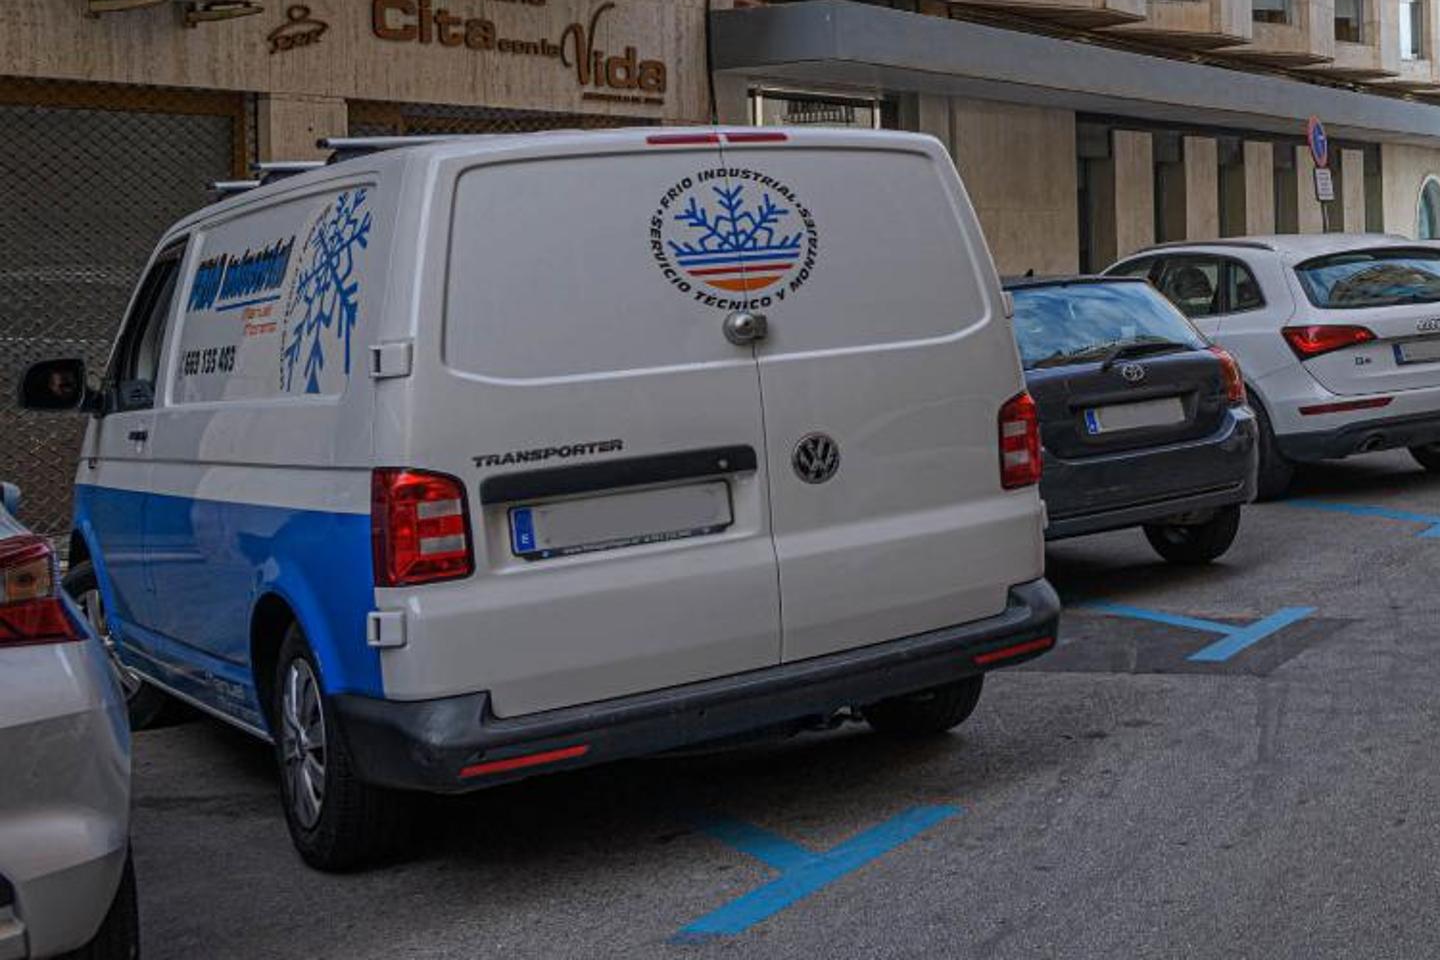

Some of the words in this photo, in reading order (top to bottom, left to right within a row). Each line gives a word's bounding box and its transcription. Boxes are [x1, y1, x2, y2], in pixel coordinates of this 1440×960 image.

[560, 1, 667, 92] Vida
[661, 176, 693, 210] FRIO
[697, 167, 797, 203] INDUSTRIAL
[650, 215, 692, 293] SERVICIO
[775, 288, 786, 301] Y
[472, 439, 624, 468] TRANSPORTER
